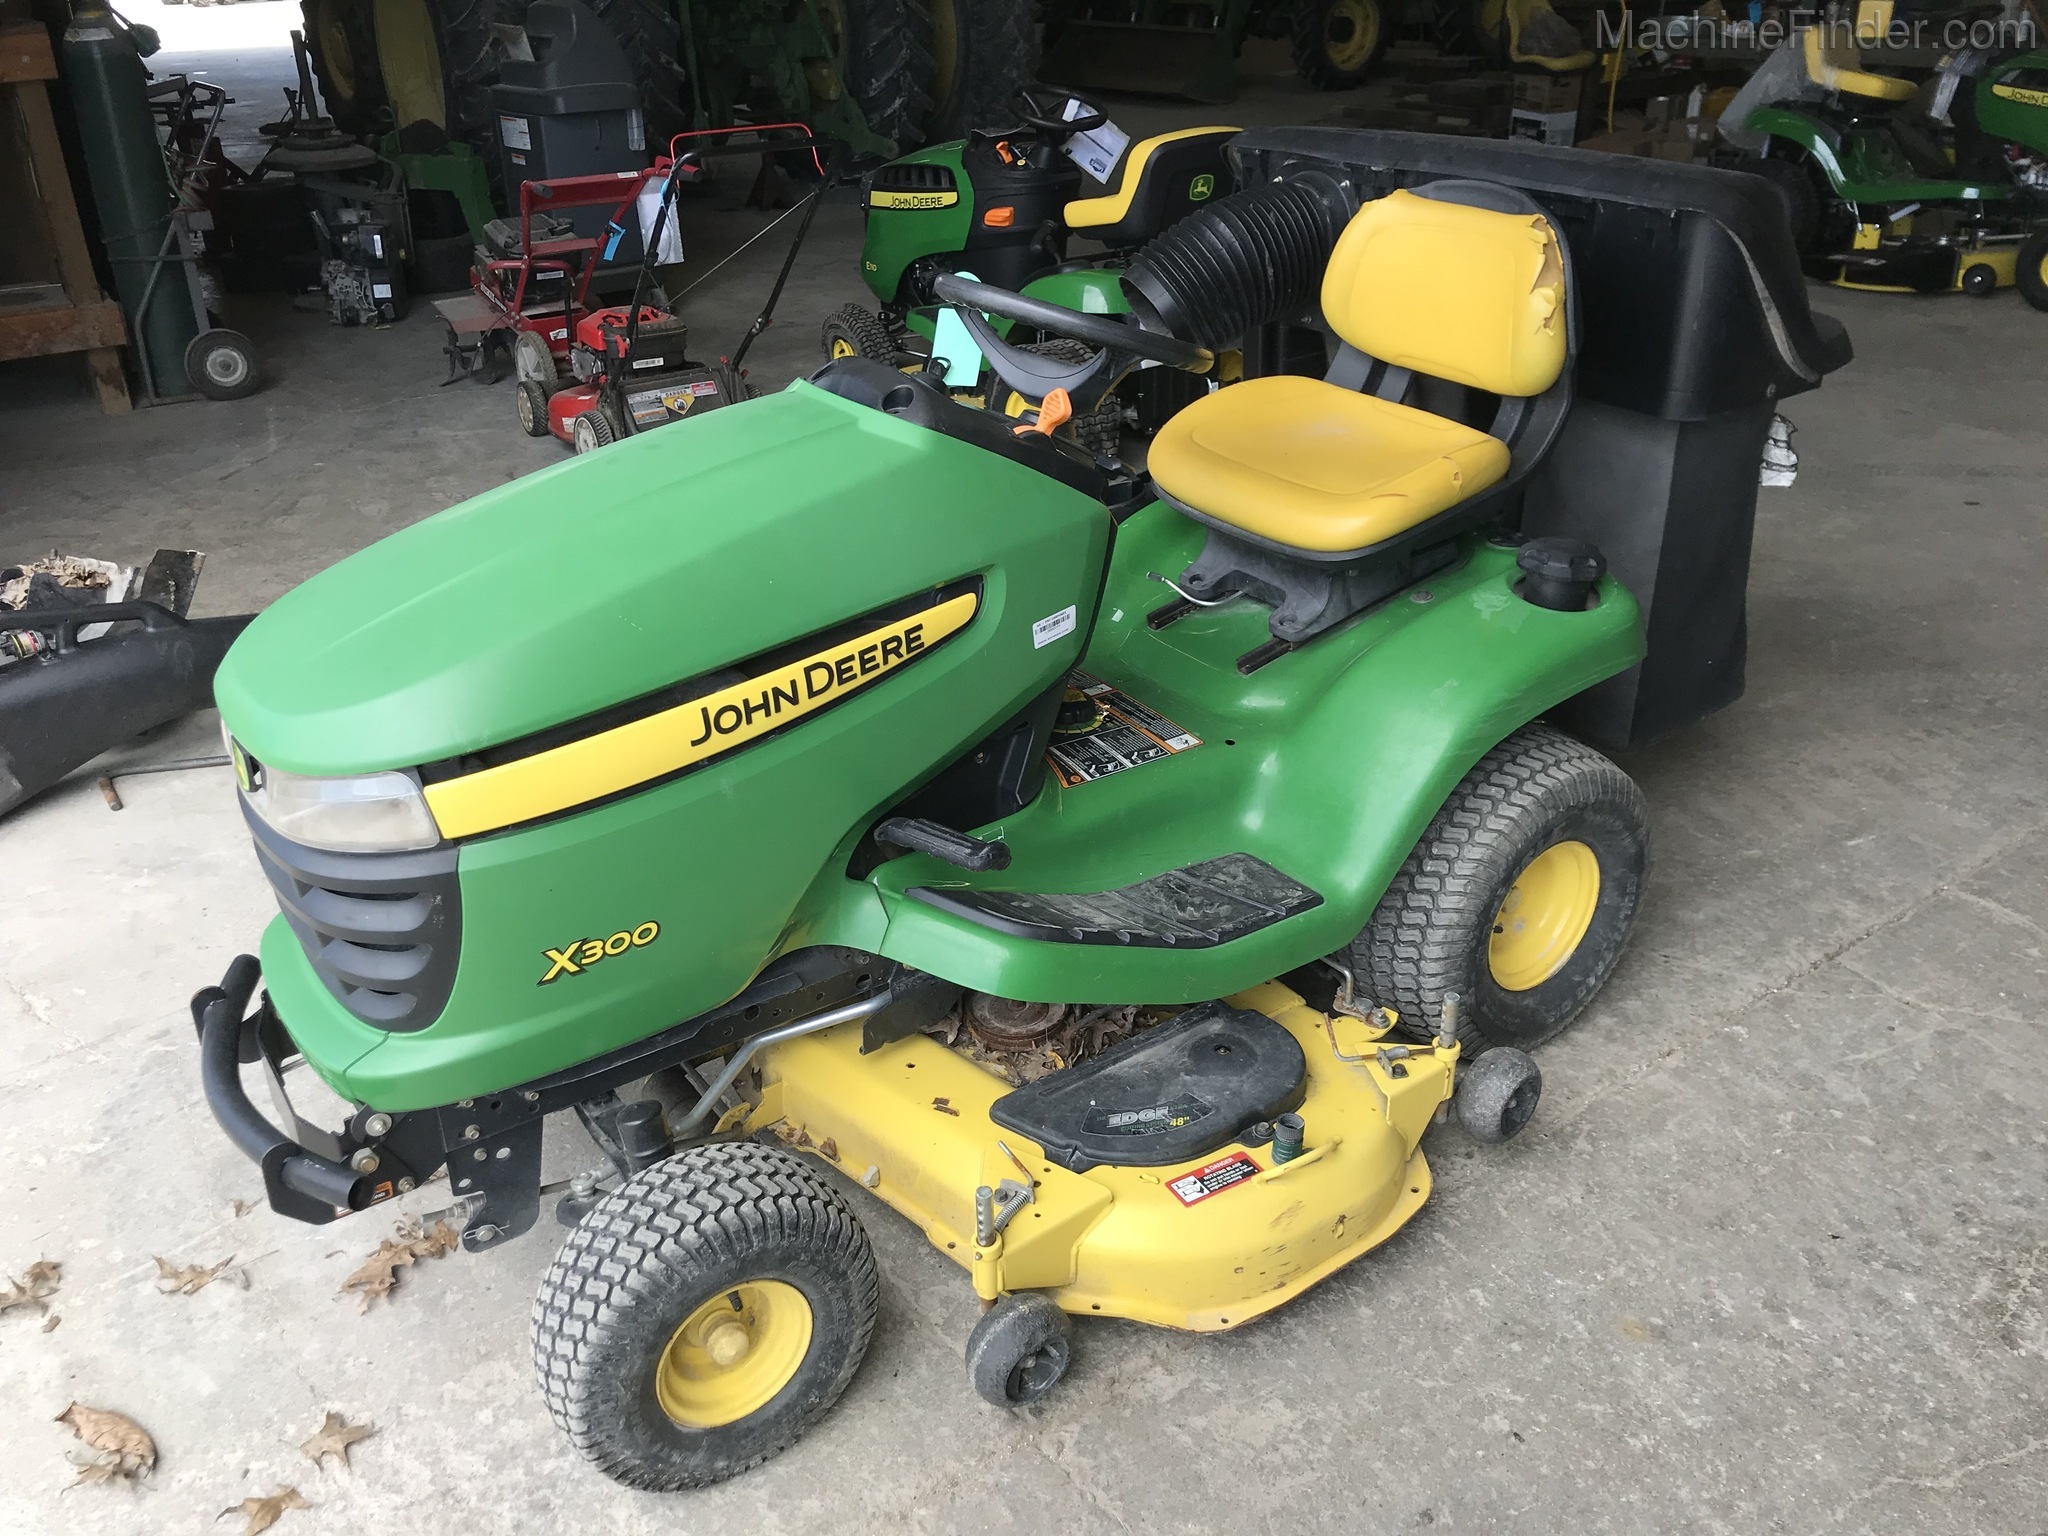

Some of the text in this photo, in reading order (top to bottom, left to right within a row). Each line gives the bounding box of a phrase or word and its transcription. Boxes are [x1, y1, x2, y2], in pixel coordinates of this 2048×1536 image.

[2008, 89, 2040, 103] JOHN
[890, 196, 943, 207] JOHN DEERE
[690, 623, 925, 747] JOHN DEERE
[537, 920, 660, 987] X300
[1169, 1116, 1190, 1127] 48"
[1209, 1157, 1235, 1170] DANGER
[1203, 1168, 1227, 1180] ROTATING
